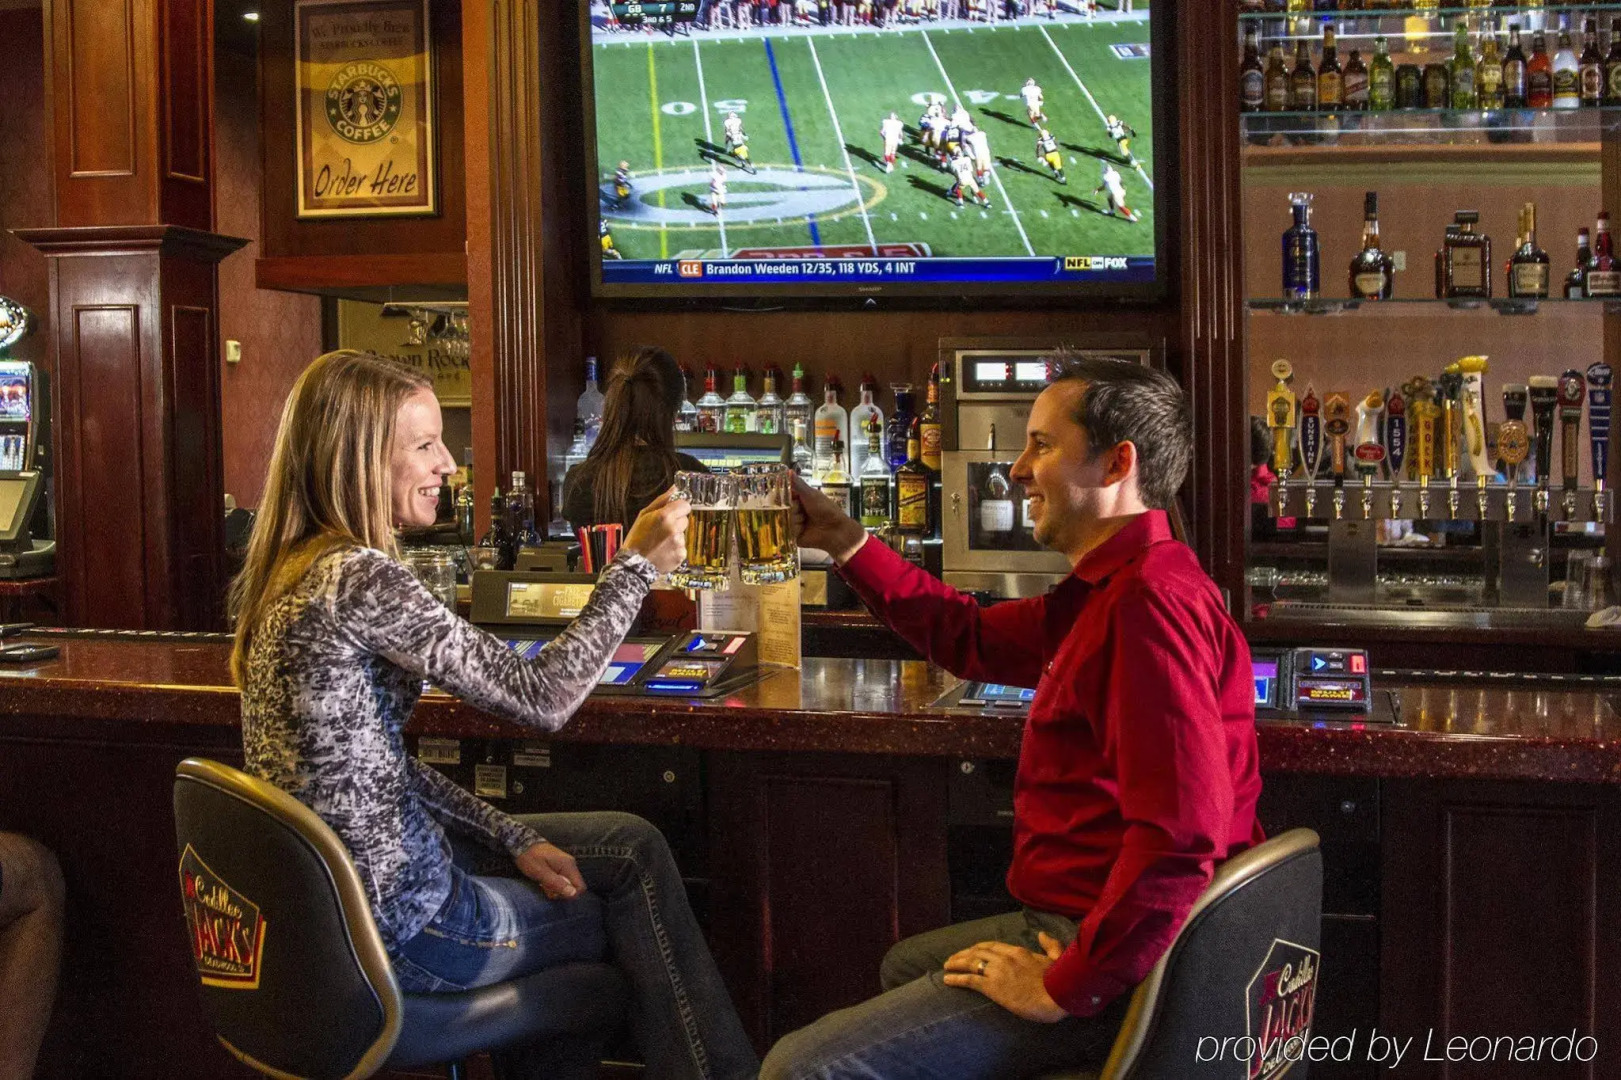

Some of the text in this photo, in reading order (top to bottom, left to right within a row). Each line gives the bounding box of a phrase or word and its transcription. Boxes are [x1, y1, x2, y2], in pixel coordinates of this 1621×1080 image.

[627, 3, 695, 13] GB 7 2ND
[327, 63, 399, 100] STARBUCKS
[336, 119, 391, 140] COFFEE
[314, 157, 417, 197] Order Here
[654, 262, 916, 276] NFL CLE Brandon Weeden 12/35, 118 YDS, 4 INT
[1066, 258, 1091, 268] NFL
[1104, 257, 1128, 269] FOX
[1307, 417, 1316, 464] SUNSHINE
[1392, 419, 1402, 457] 1554
